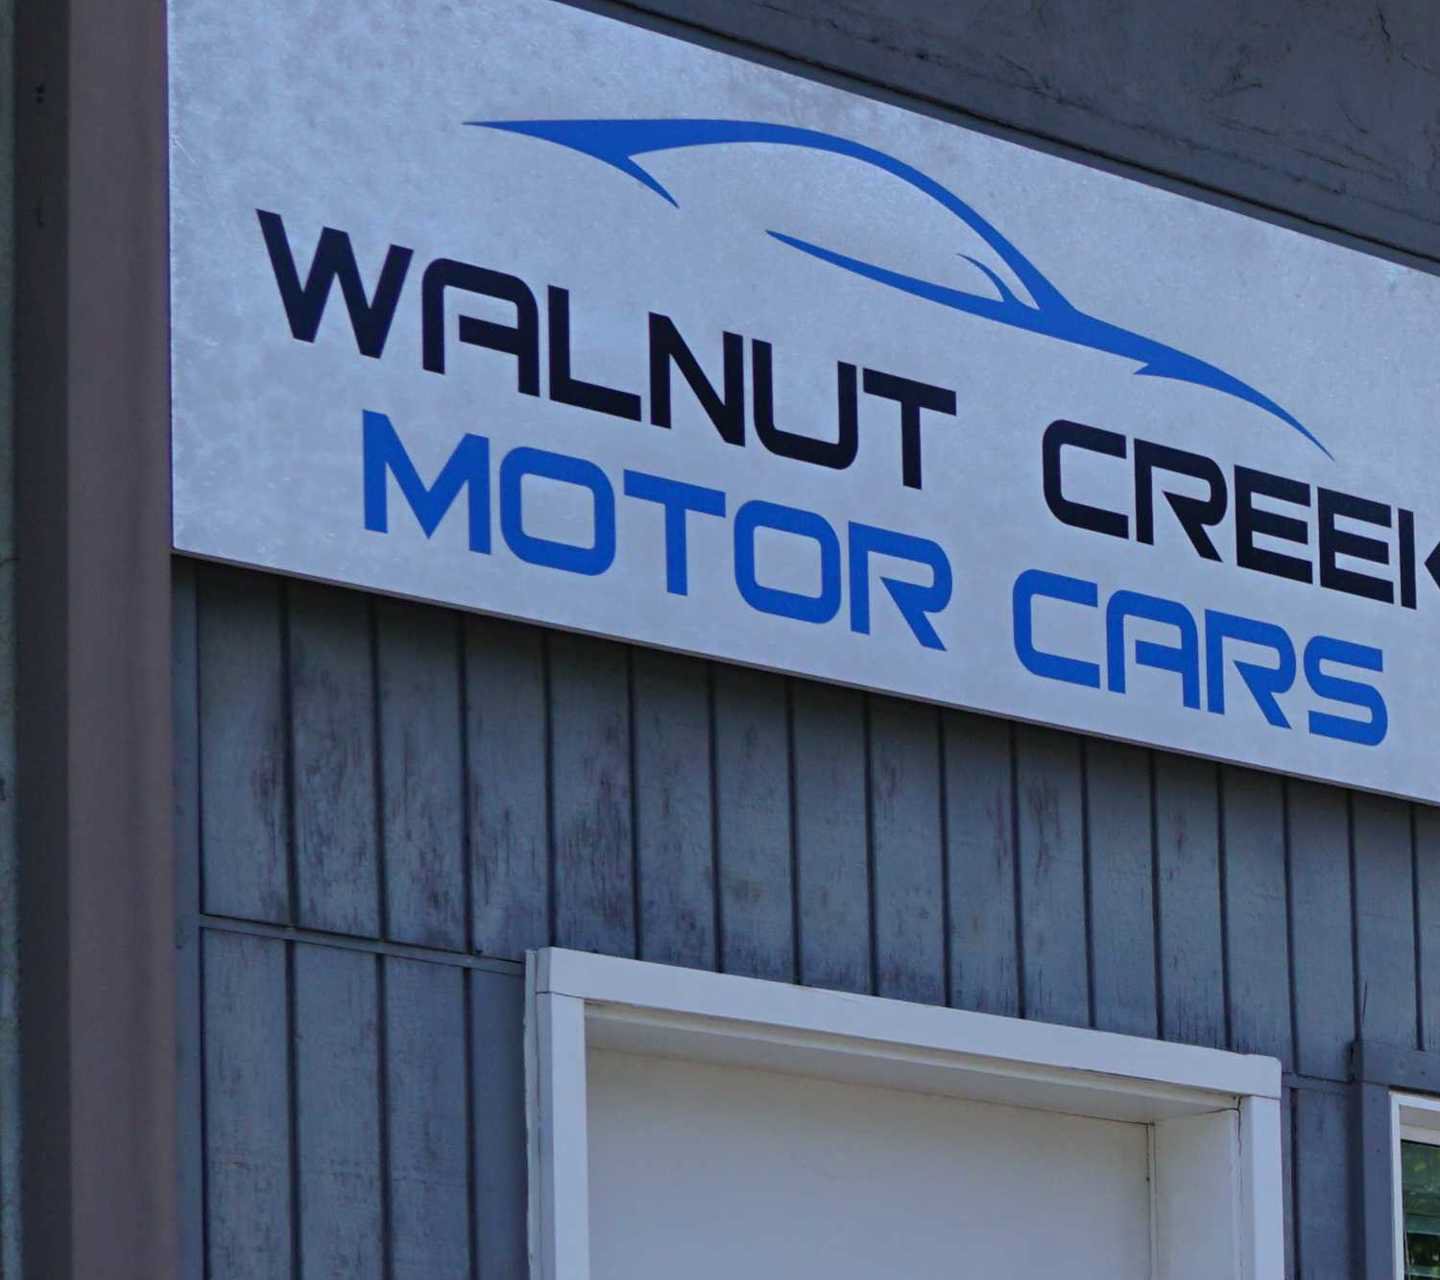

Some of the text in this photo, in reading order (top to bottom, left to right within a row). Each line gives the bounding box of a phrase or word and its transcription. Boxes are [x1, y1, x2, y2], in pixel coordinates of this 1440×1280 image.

[256, 210, 957, 490] WALNUT
[361, 410, 1388, 747] MOTOR CARS
